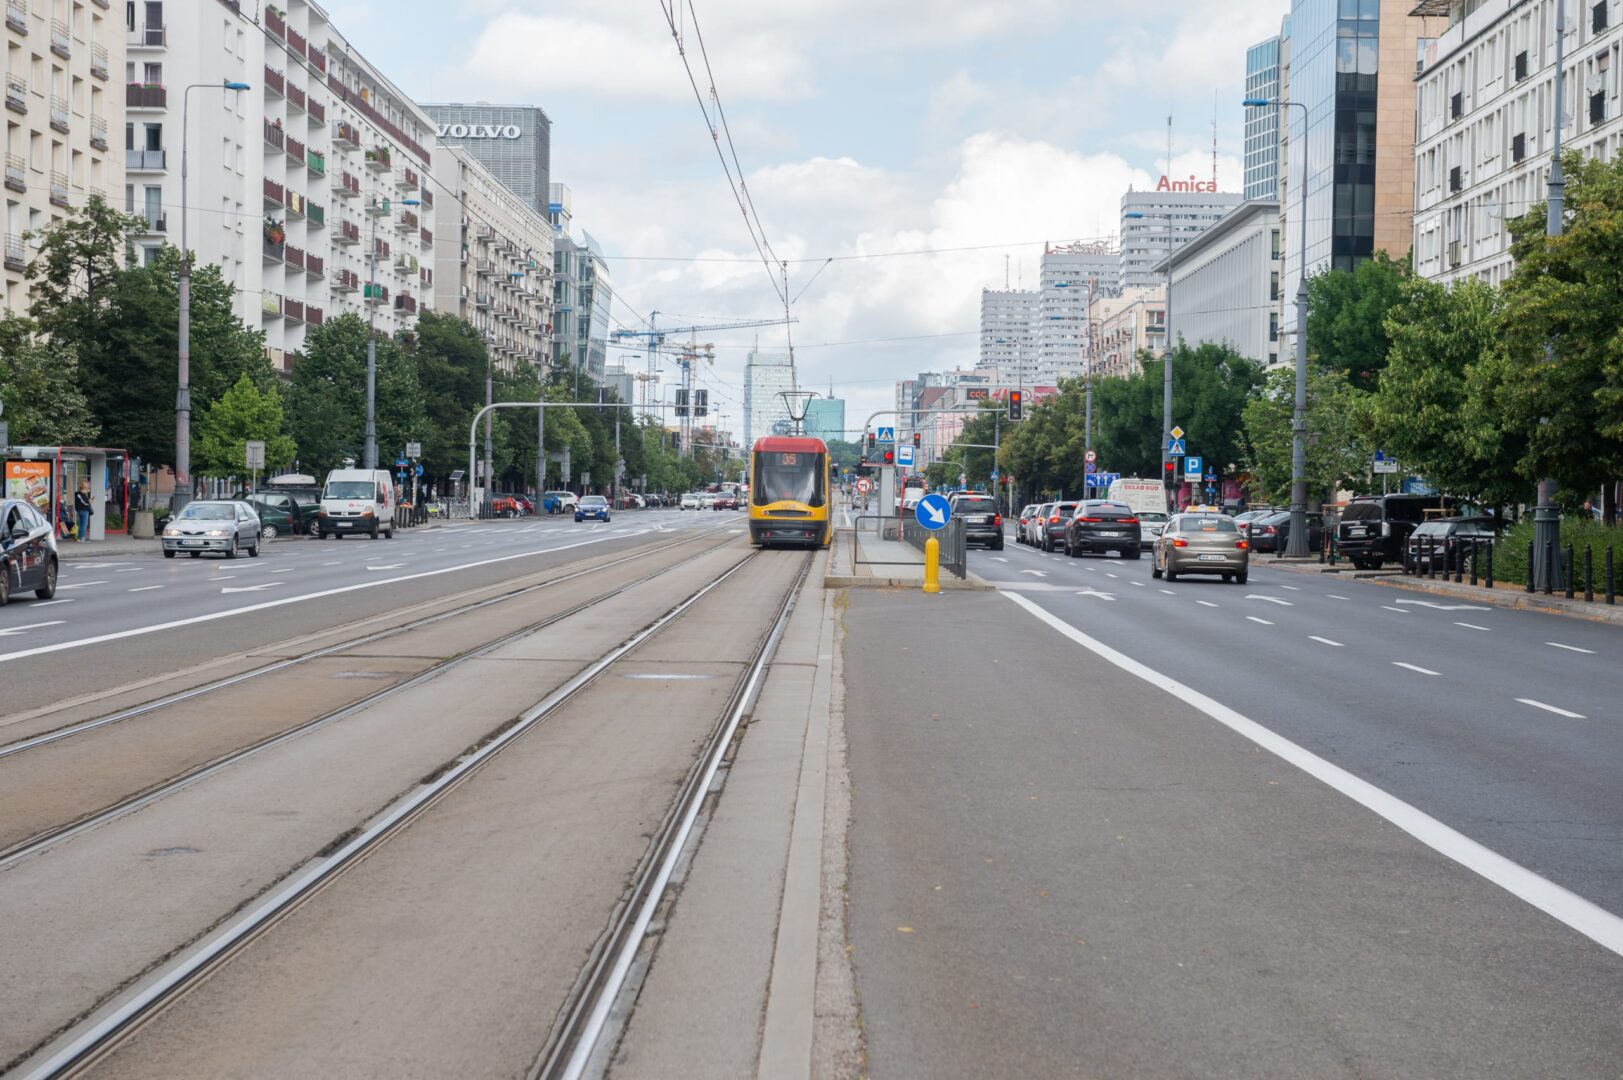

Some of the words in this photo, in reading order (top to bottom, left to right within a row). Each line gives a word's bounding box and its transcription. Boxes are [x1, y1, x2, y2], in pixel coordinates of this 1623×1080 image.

[436, 124, 521, 139] VOLVO
[1155, 174, 1217, 193] Amica
[969, 391, 987, 399] CCC
[1188, 458, 1199, 473] P
